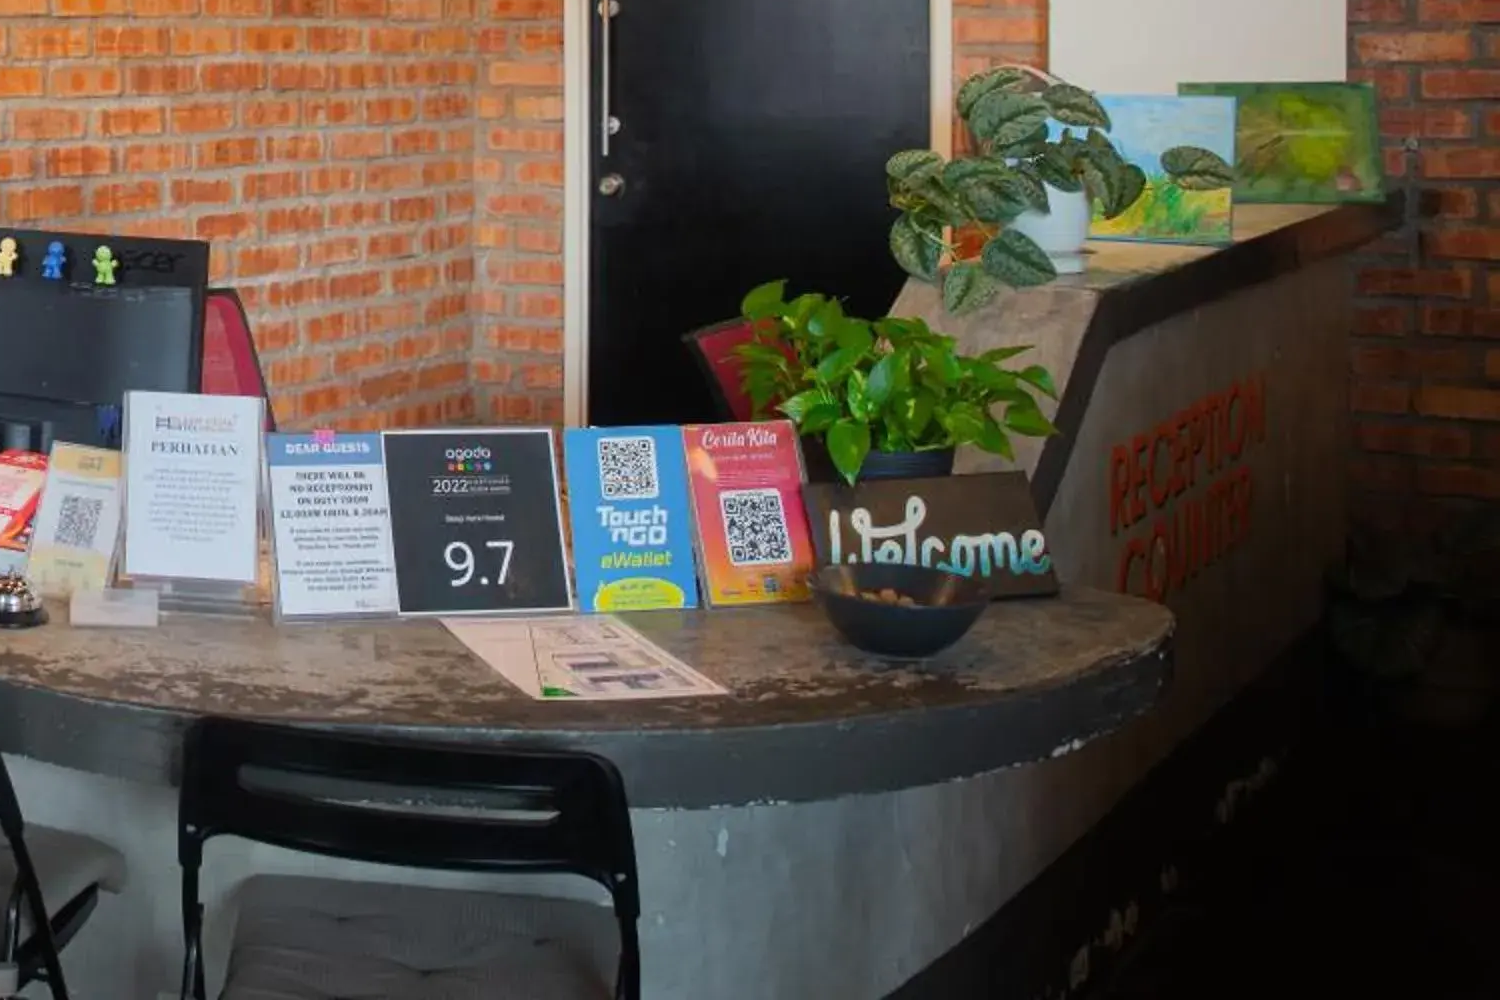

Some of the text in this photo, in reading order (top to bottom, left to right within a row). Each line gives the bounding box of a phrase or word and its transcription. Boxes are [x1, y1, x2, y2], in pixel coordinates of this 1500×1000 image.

[150, 440, 238, 457] PERHATIAN
[285, 441, 371, 455] DEAR GUESTS
[445, 445, 491, 462] agoda
[1108, 371, 1266, 537] RECEPTION
[432, 479, 469, 494] 2022
[595, 504, 668, 527] Touch
[443, 540, 515, 587] 9.7
[600, 551, 672, 569] eWallet
